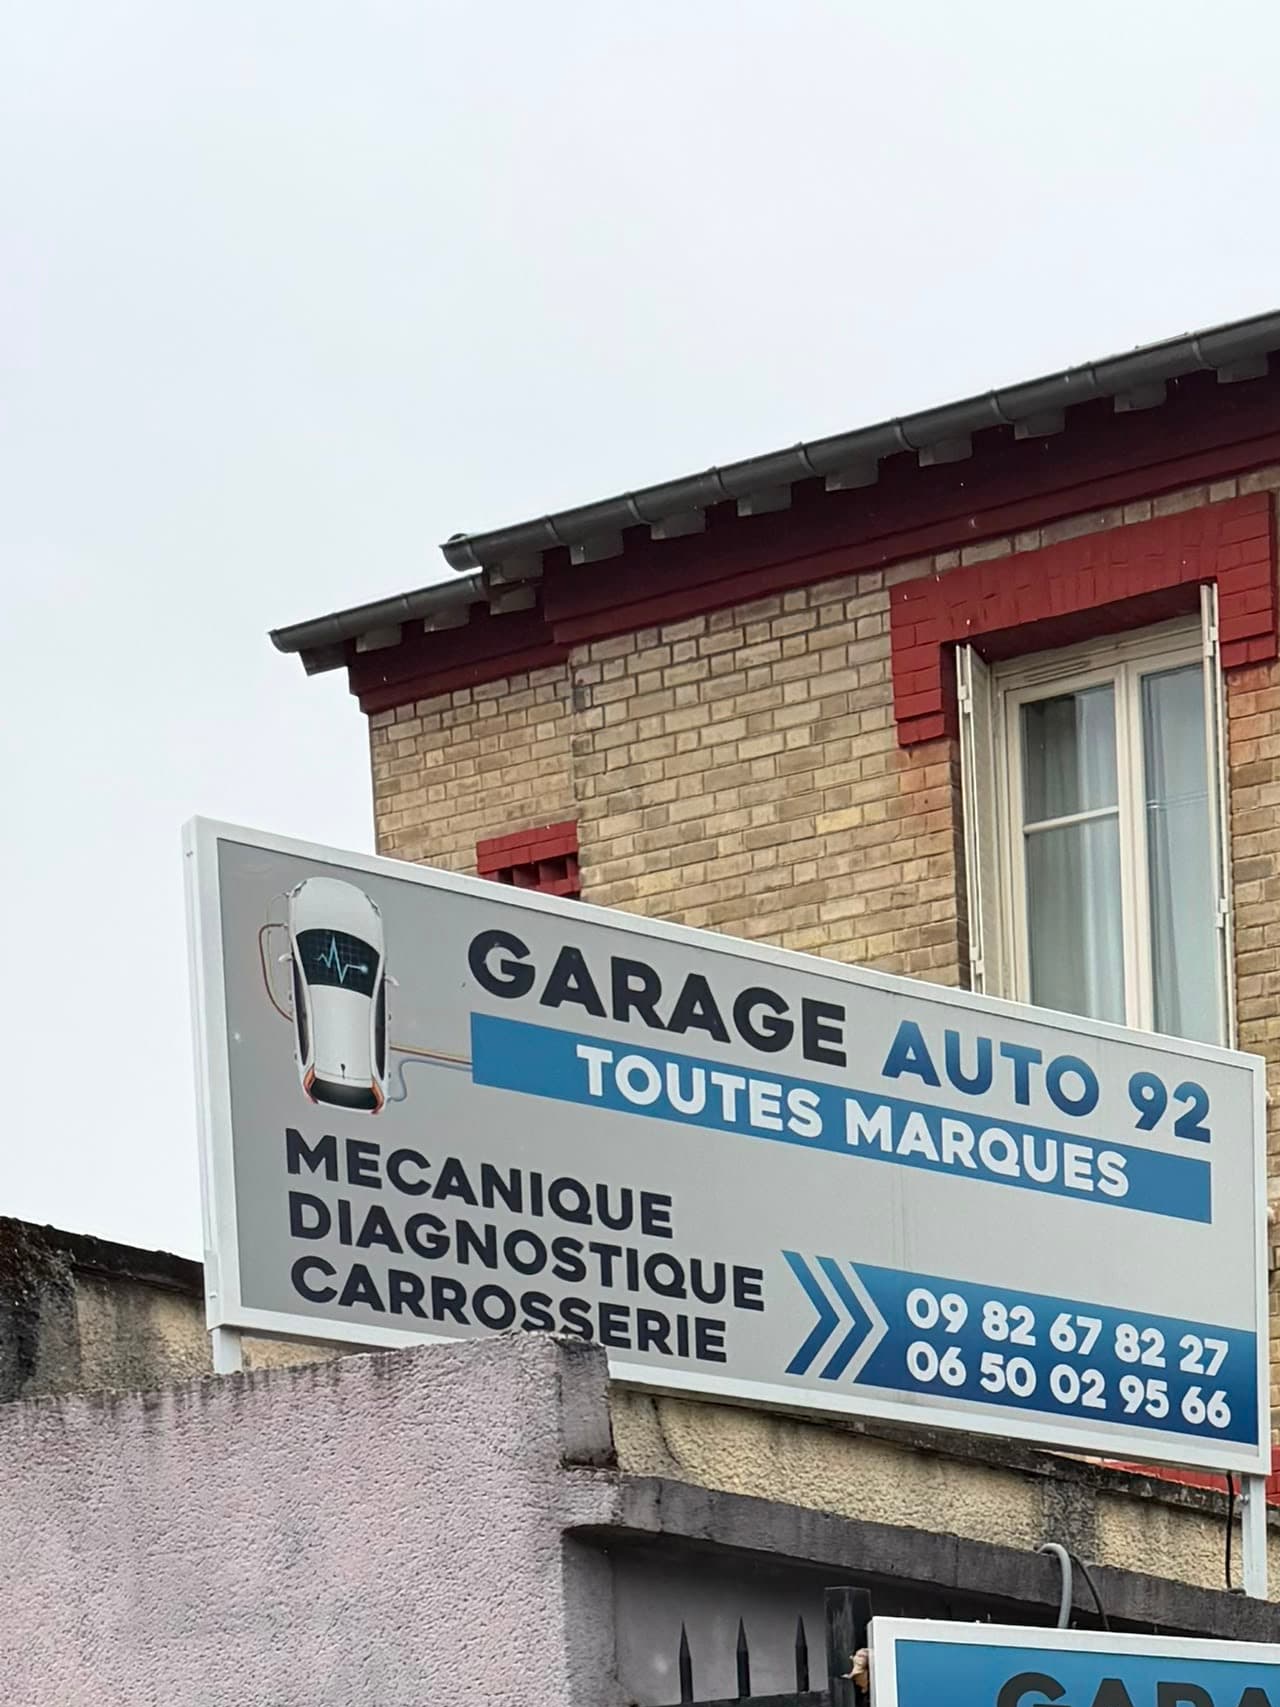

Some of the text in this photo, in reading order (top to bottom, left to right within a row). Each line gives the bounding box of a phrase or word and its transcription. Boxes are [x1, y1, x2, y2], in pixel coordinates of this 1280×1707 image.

[467, 929, 1211, 1143] GARAGE AUTO 92
[576, 1044, 1129, 1198] TOUTES MARQUES
[285, 1128, 673, 1239] MECANIQUE
[288, 1191, 765, 1312] DIAGNOSTIQUE
[291, 1255, 727, 1363] CARROSSERIE
[906, 1288, 1229, 1376] 09 82 67 82 27
[906, 1341, 1231, 1429] 06 50 02 95 66
